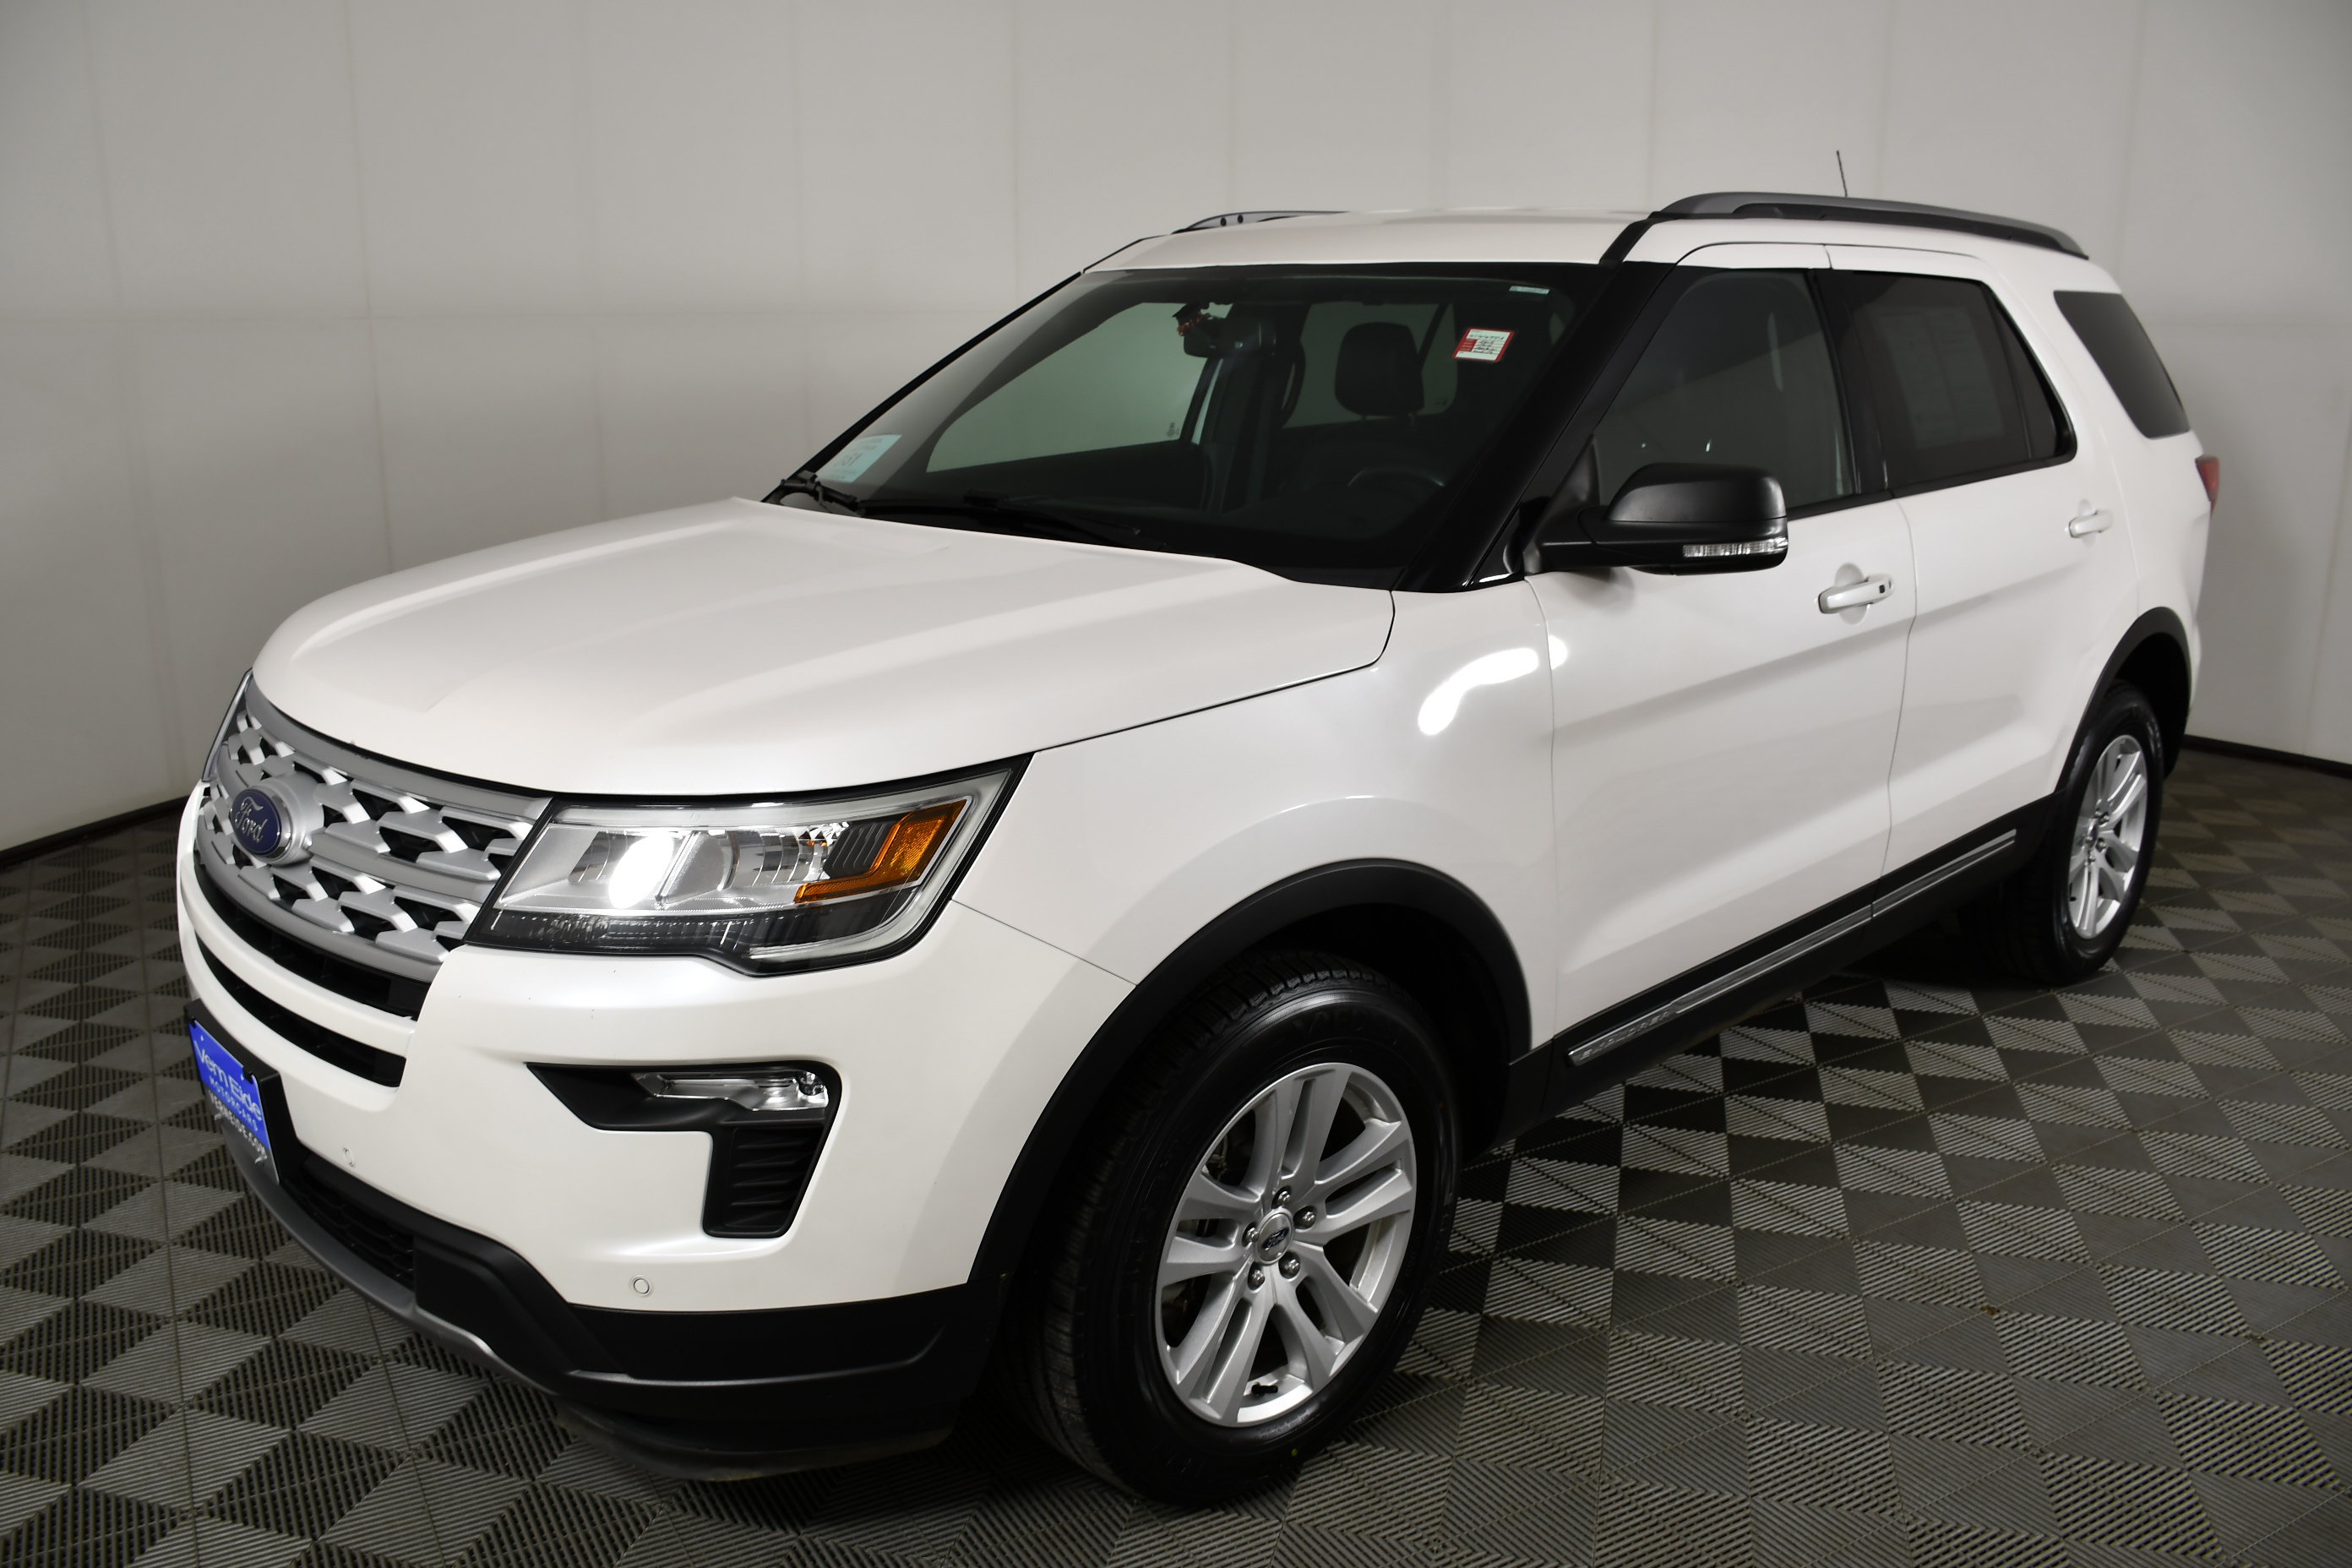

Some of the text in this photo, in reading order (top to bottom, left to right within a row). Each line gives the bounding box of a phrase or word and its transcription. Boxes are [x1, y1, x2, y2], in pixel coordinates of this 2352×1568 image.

[235, 797, 269, 843] Ford
[193, 1040, 263, 1122] Vern Eide
